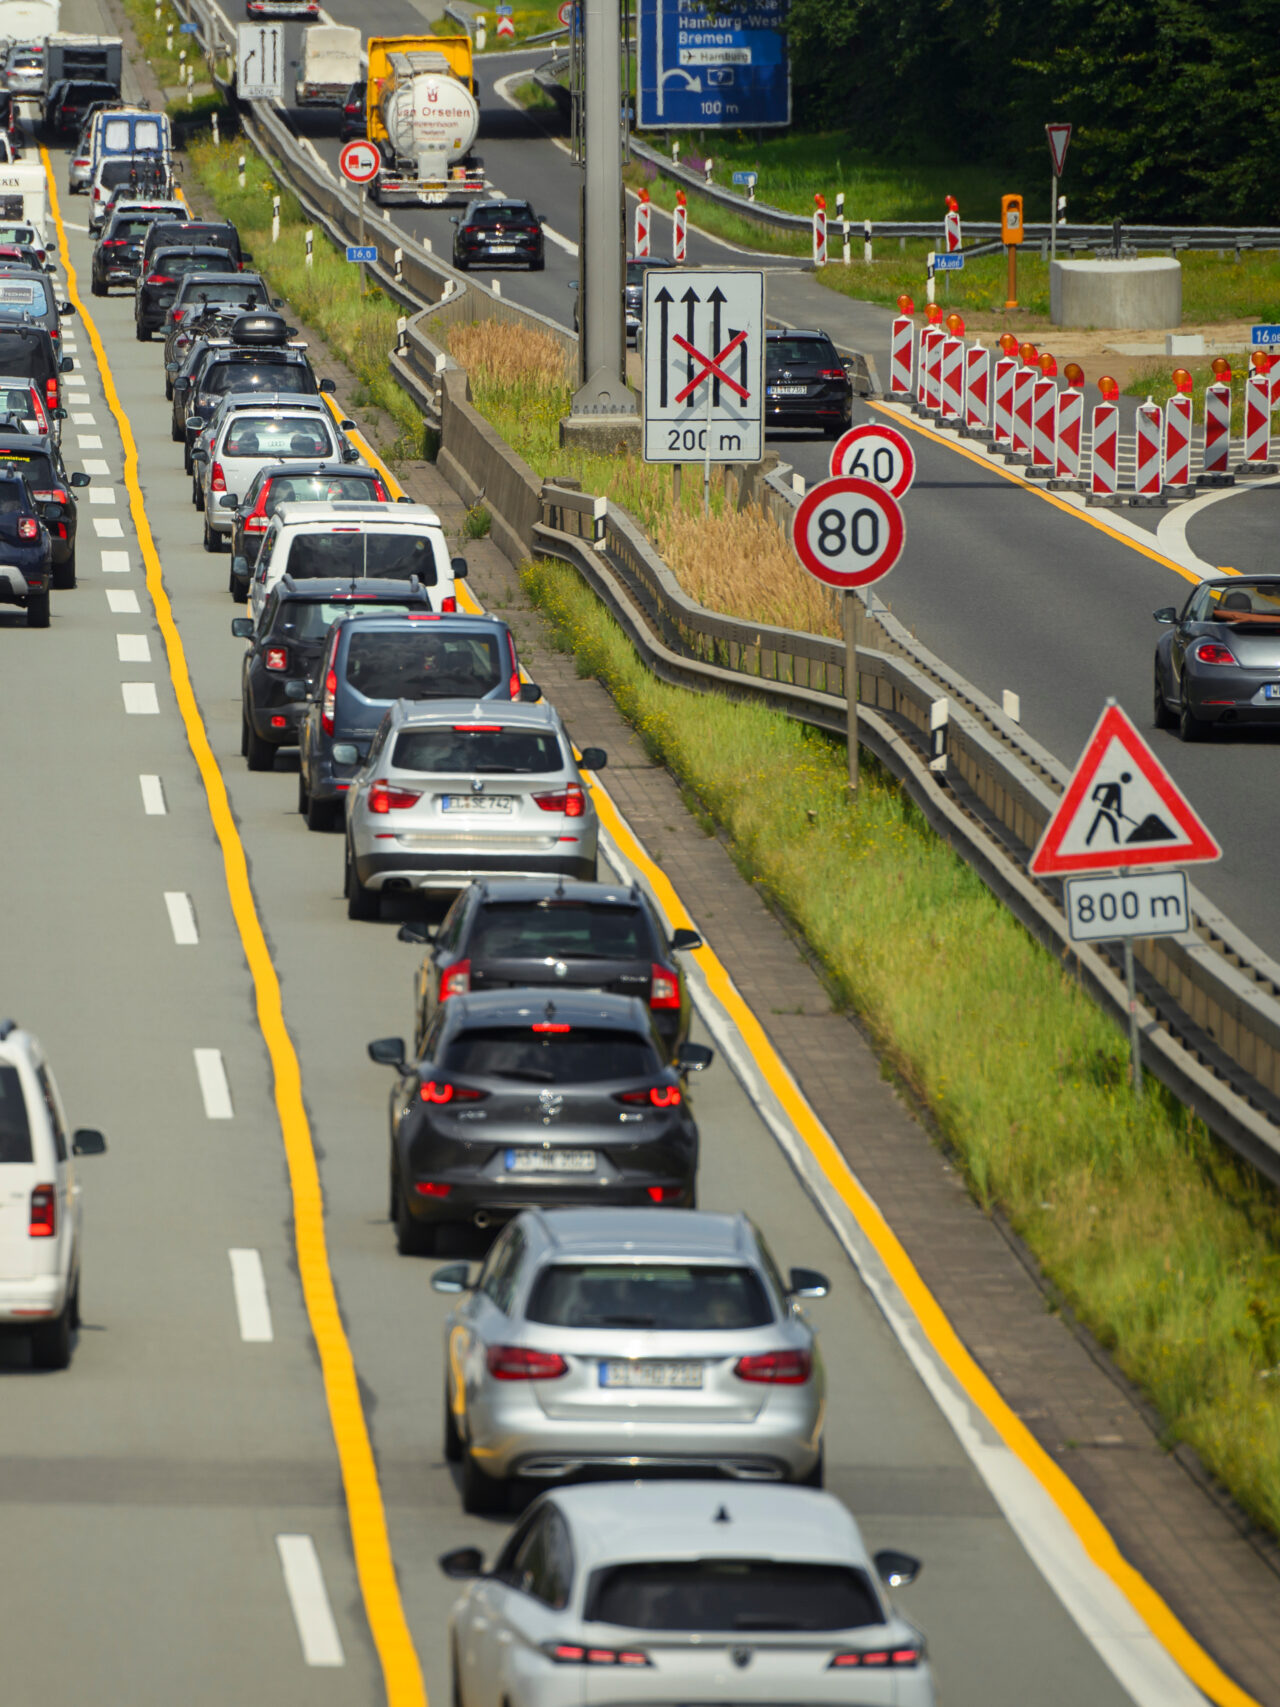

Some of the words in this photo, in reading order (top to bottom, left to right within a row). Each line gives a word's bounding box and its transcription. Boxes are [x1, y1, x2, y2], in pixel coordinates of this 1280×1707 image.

[679, 31, 733, 44] Bremen
[700, 52, 750, 63] Hamburg
[422, 107, 471, 118] Orselen
[701, 101, 721, 114] 100
[726, 105, 739, 114] m
[352, 249, 372, 259] 16.0
[668, 429, 708, 451] 200
[720, 434, 741, 451] m
[849, 447, 894, 483] 60
[818, 507, 879, 557] 80
[488, 797, 511, 809] 742
[1078, 891, 1139, 923] 800
[1151, 895, 1181, 918] m
